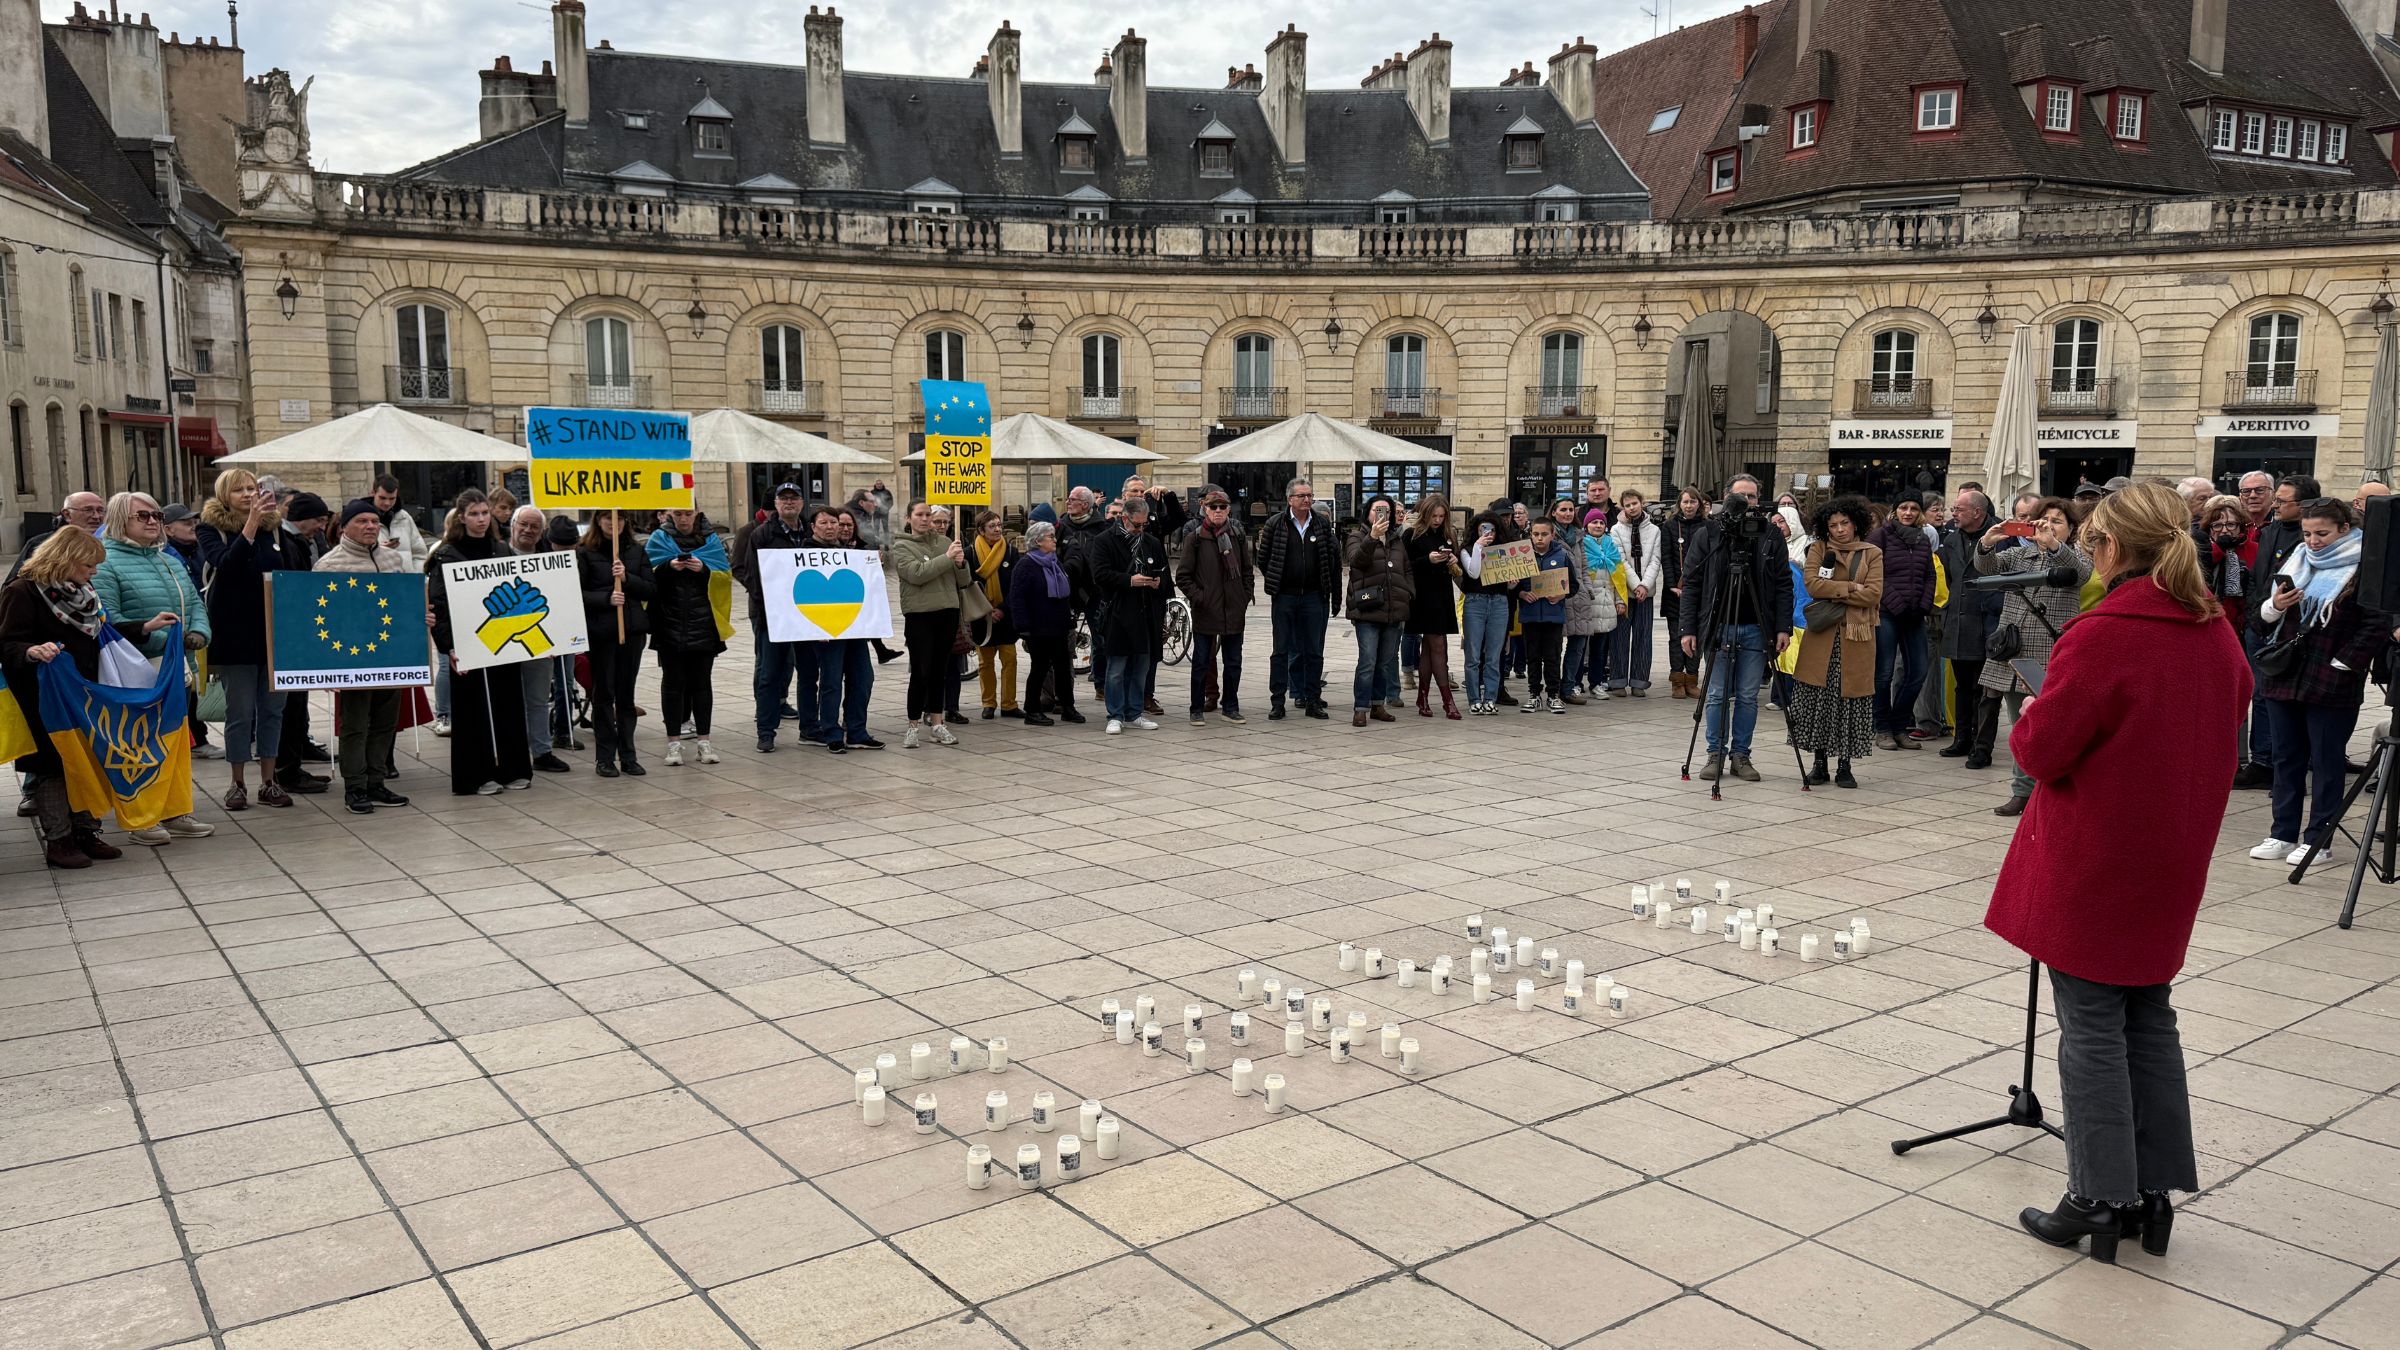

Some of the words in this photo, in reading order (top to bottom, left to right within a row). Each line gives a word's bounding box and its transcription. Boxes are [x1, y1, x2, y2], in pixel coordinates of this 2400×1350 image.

[642, 421, 687, 441] WITH
[1524, 425, 1594, 434] IMMOBILIER
[2227, 420, 2310, 431] APERITIVO
[1838, 429, 1864, 439] BAR
[1872, 429, 1944, 439] BRASSERIE
[2037, 427, 2120, 440] HÉMICYCLE
[940, 441, 983, 458] STOP
[932, 462, 956, 476] THE
[958, 462, 986, 477] WAR
[544, 469, 642, 496] UKRAINE
[934, 481, 946, 494] IN
[949, 481, 986, 494] EUROPE
[794, 551, 848, 567] MERCI
[453, 560, 517, 582] L'UKRAINE
[521, 557, 541, 573] EST
[542, 553, 572, 571] UNIE
[355, 672, 391, 682] NOTRE
[393, 670, 429, 680] FORCE
